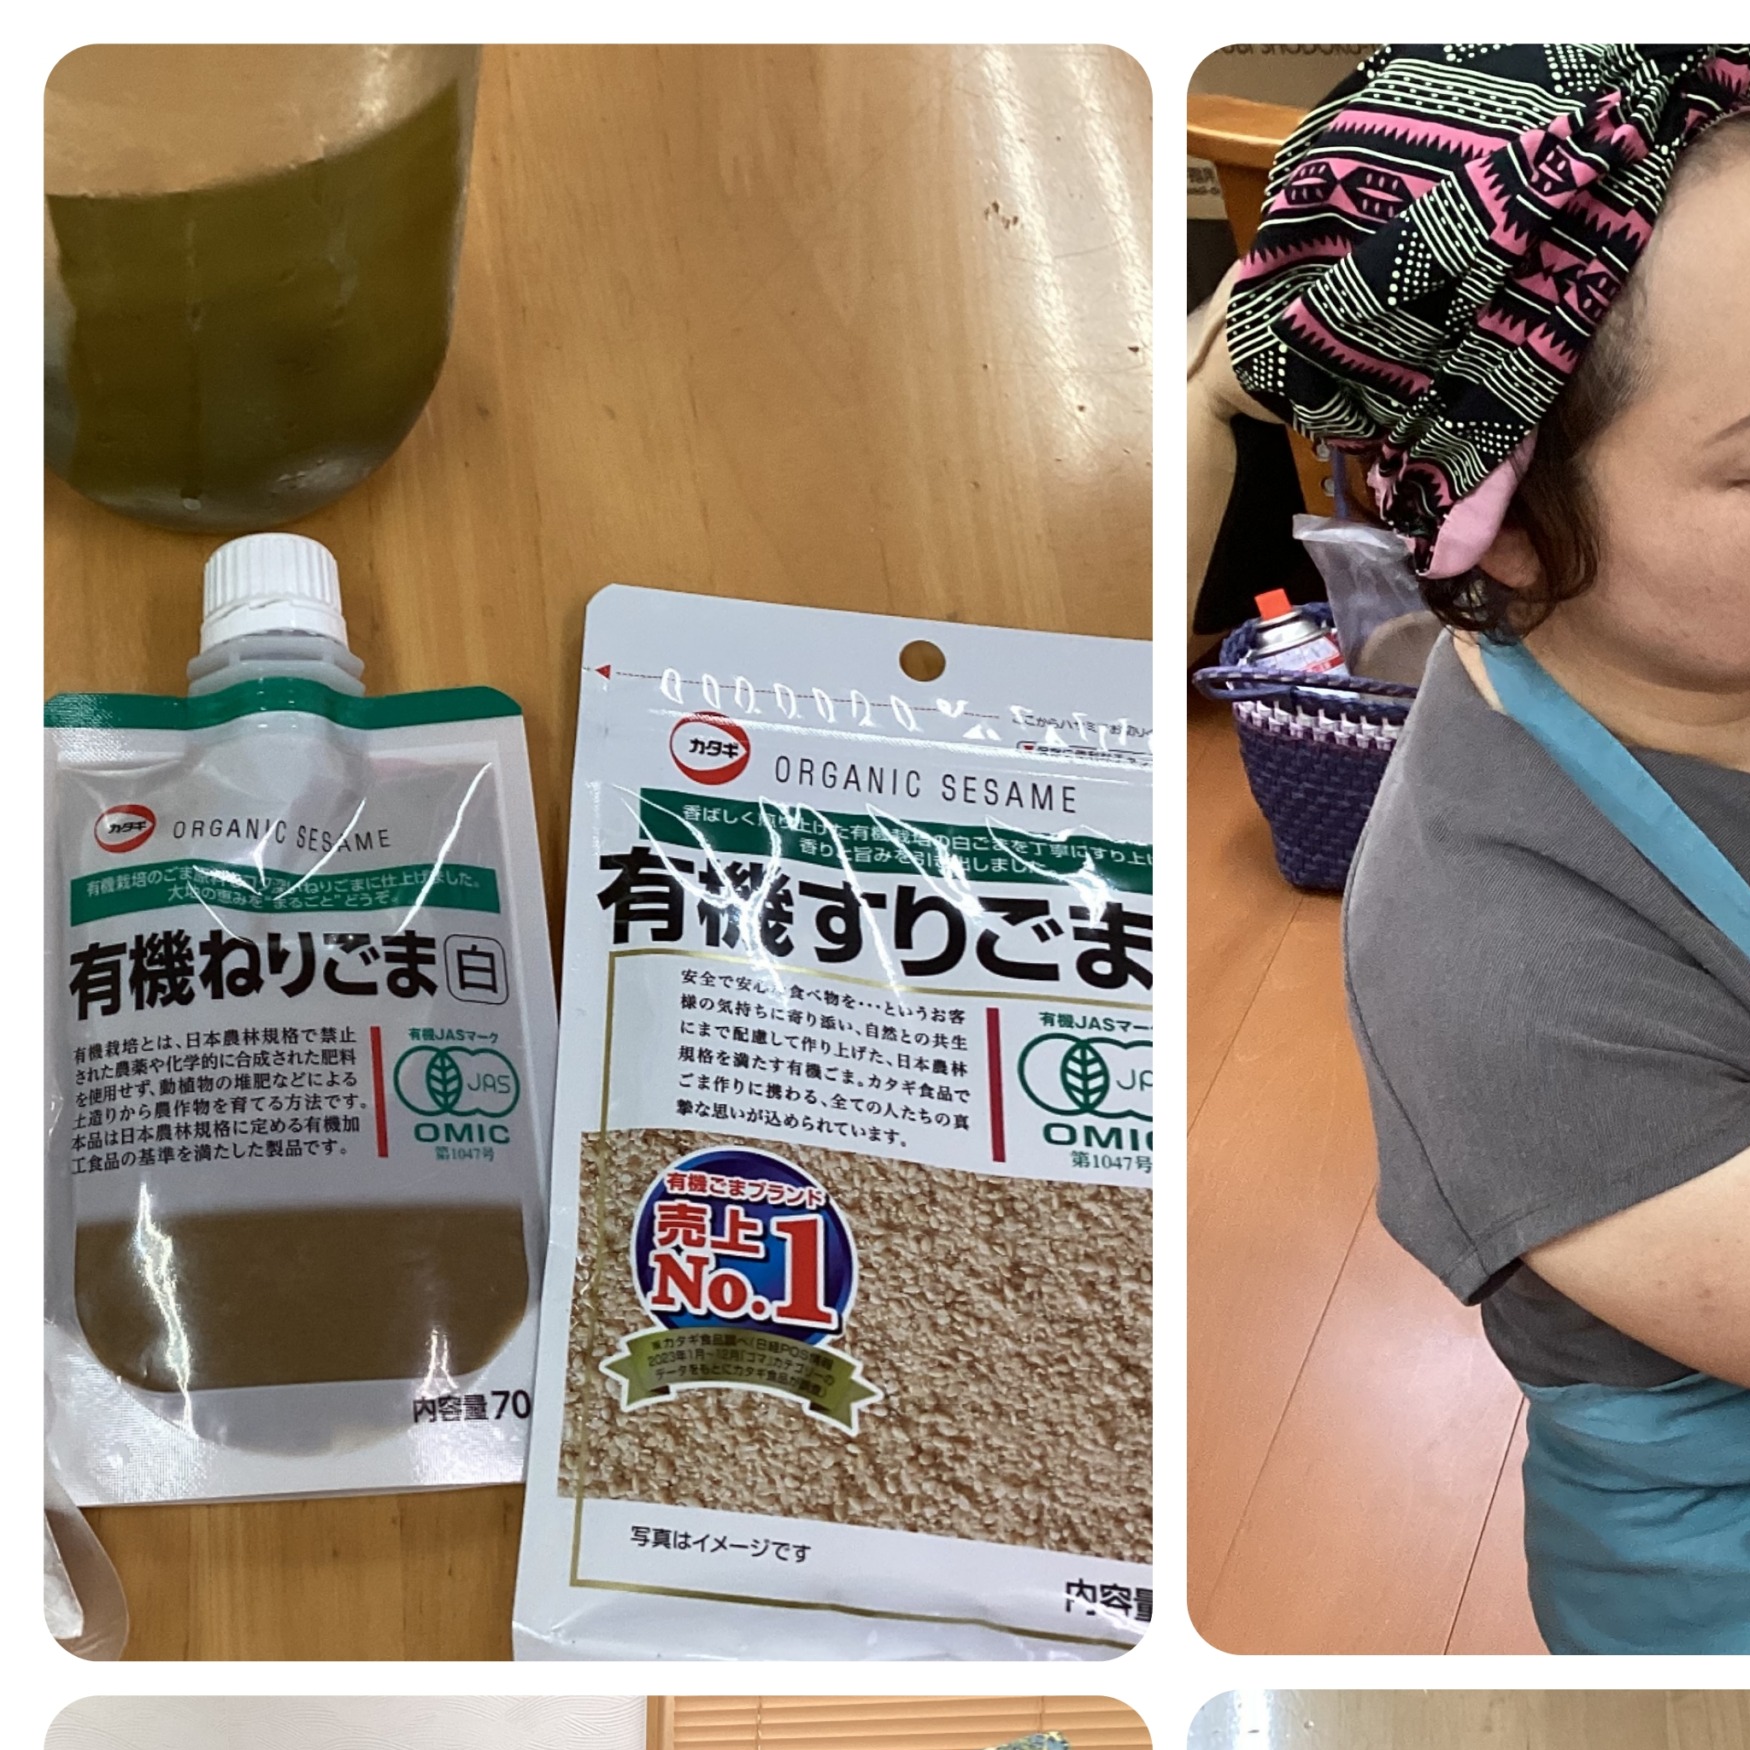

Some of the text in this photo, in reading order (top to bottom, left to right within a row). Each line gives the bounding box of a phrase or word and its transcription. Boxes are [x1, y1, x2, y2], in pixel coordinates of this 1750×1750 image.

[689, 737, 740, 759] カタギ
[775, 754, 1077, 814] ORGANIC SESAME
[107, 819, 147, 835] カタギ
[173, 818, 392, 853] ORGANIC SESAME
[597, 846, 1153, 990] 有機すりごま
[69, 929, 497, 1020] 有機ねりごま 白
[408, 1027, 499, 1044] 有機JASマーク
[680, 993, 968, 1051] 様の気持ちに寄り添い、自然との共生
[1038, 1011, 1153, 1033] 有機JASマー
[73, 1026, 357, 1065] 有機栽培とは、日本農林規格で禁止
[680, 1019, 968, 1077] にまで配慮して作り上げた、日本農林
[74, 1047, 356, 1086] された農薬や化学的に合成された肥料
[467, 1073, 511, 1095] JAS
[678, 1045, 971, 1104] 規格を満たす有機ごま。カタギ食品で
[74, 1069, 358, 1108] を使用せず、動植物の堆肥などによる
[678, 1072, 970, 1131] ごま作りに携わる、全ての人たちの真
[72, 1090, 368, 1131] 土造りから農作物を育てる方法です。
[676, 1099, 907, 1148] 摯な思いが込められています。
[71, 1114, 360, 1153] 本品は日本農林規格に定める有機加
[413, 1122, 511, 1145] OMIC
[1043, 1122, 1153, 1152] OMI
[70, 1136, 349, 1175] 工食品の基準を満たした製品です。
[435, 1145, 495, 1162] 第1047号
[1071, 1150, 1153, 1174] 第1047号
[666, 1172, 825, 1208] 有機ごまブランド
[656, 1202, 761, 1255] 売上
[651, 1217, 833, 1325] No.1
[630, 1524, 811, 1564] 写真はイメージです
